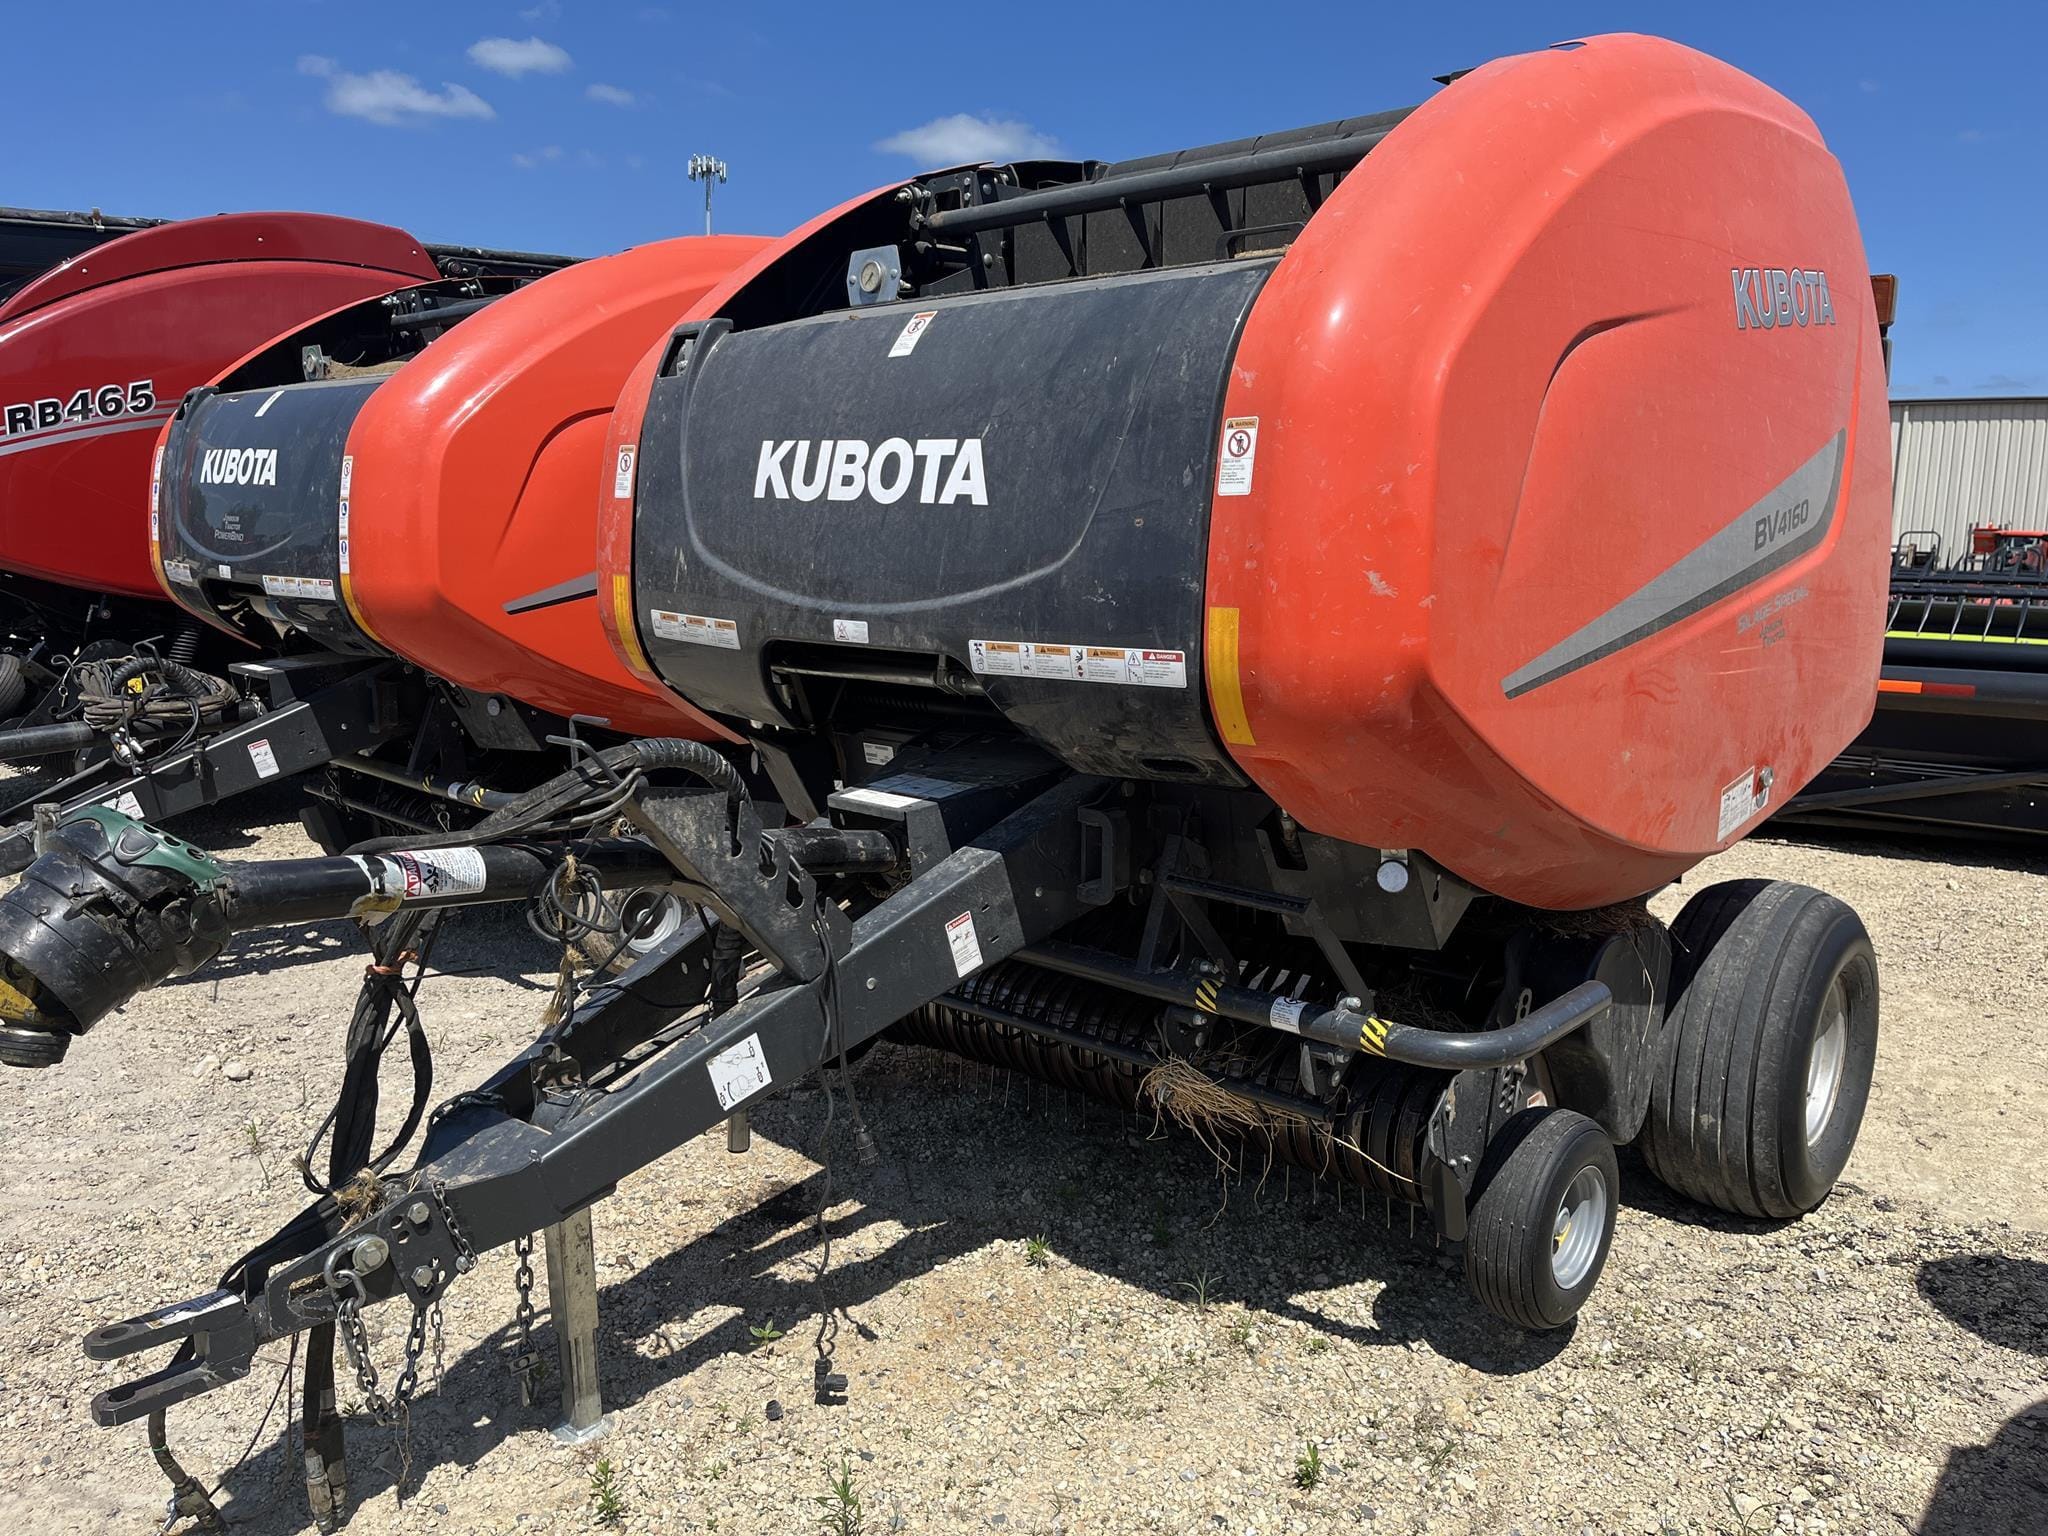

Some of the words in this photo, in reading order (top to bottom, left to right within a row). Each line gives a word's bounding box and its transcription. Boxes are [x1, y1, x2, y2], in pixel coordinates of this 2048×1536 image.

[1731, 268, 1836, 329] KUBOTA
[4, 379, 156, 436] RB465
[200, 448, 278, 486] KUBOTA
[753, 437, 989, 506] KUBOTA
[1754, 498, 1809, 552] BV4160
